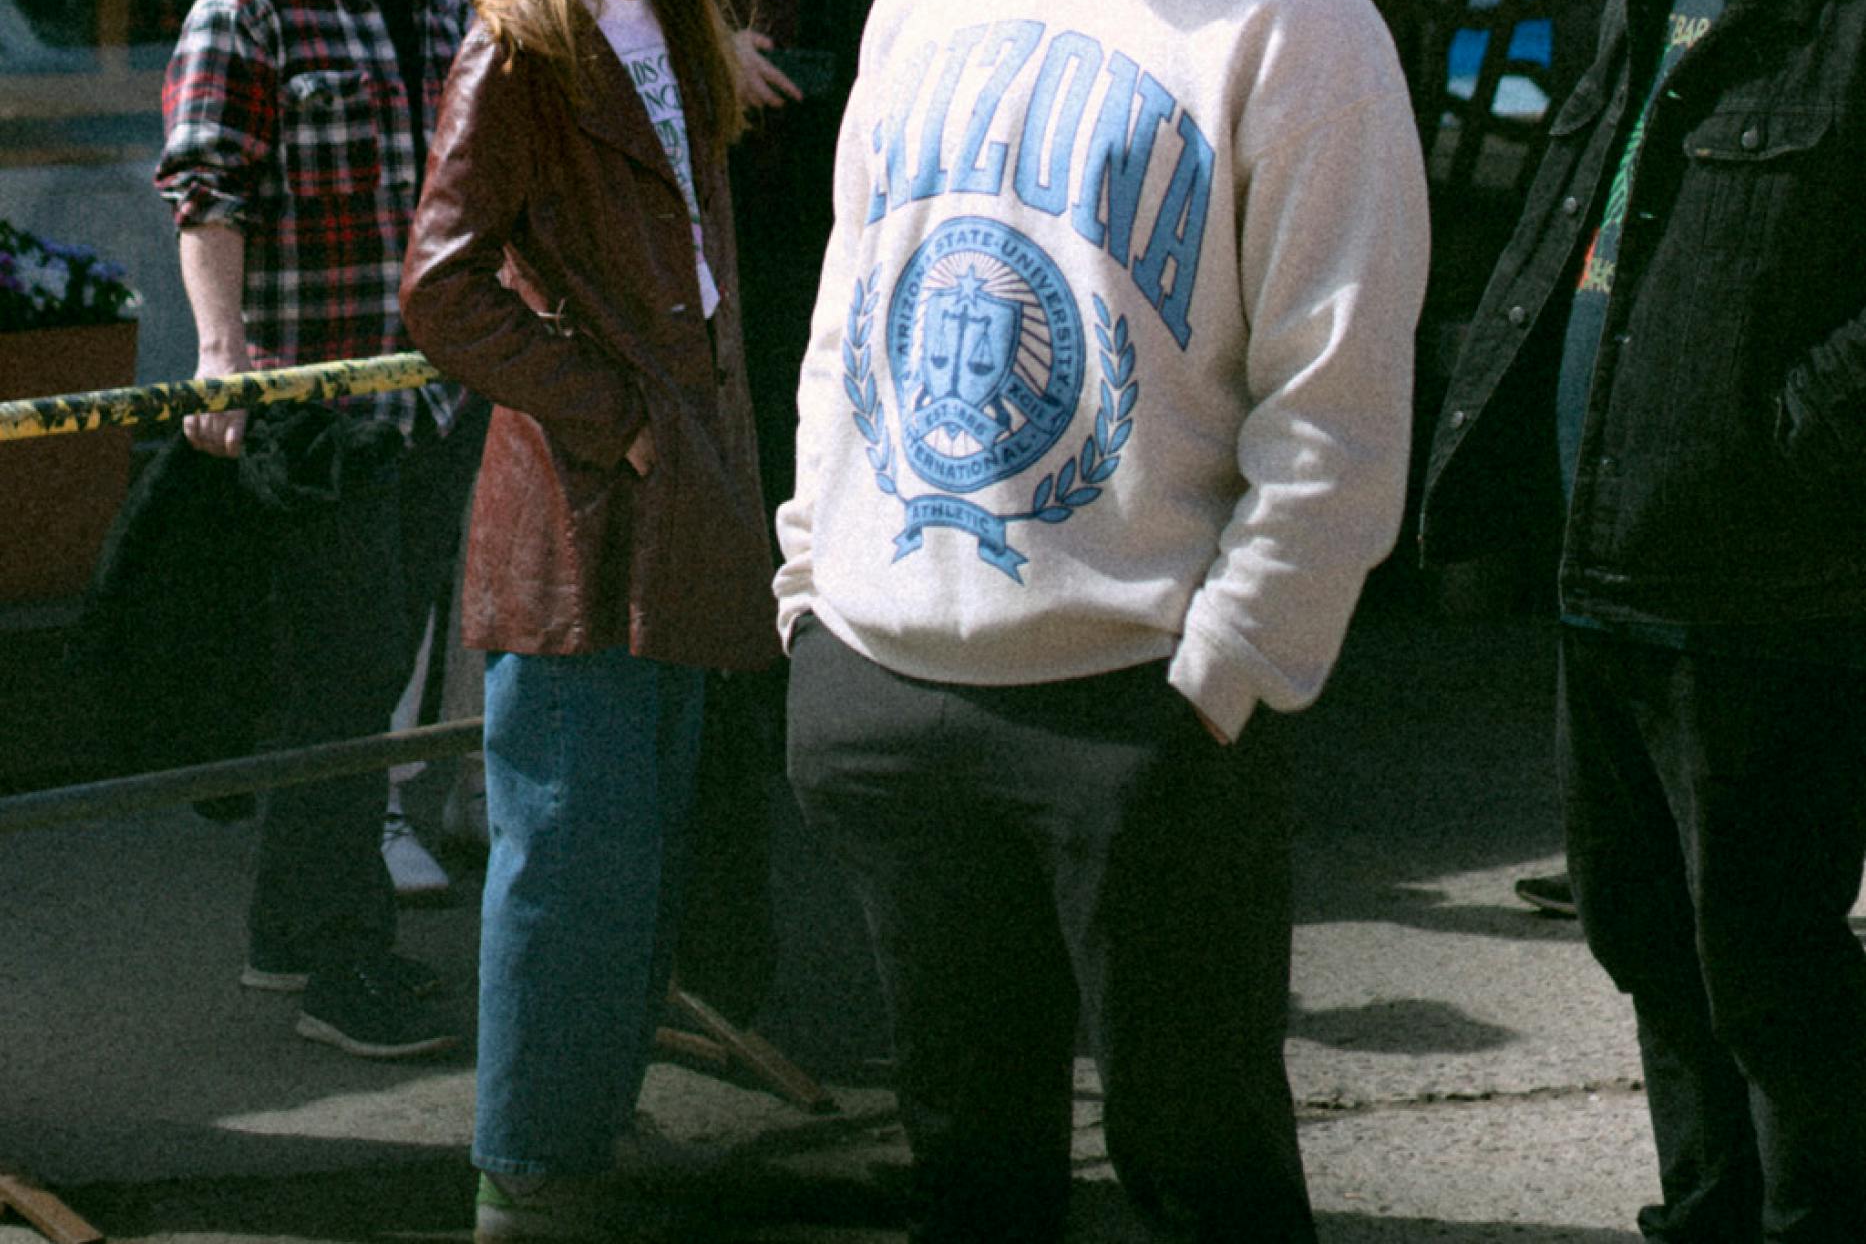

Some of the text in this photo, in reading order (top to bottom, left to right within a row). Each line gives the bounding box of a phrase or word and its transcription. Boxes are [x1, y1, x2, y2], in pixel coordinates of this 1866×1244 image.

[934, 228, 994, 254] STATE
[1001, 243, 1074, 387] UNIVERSITY
[911, 503, 990, 534] ATHLETIC
